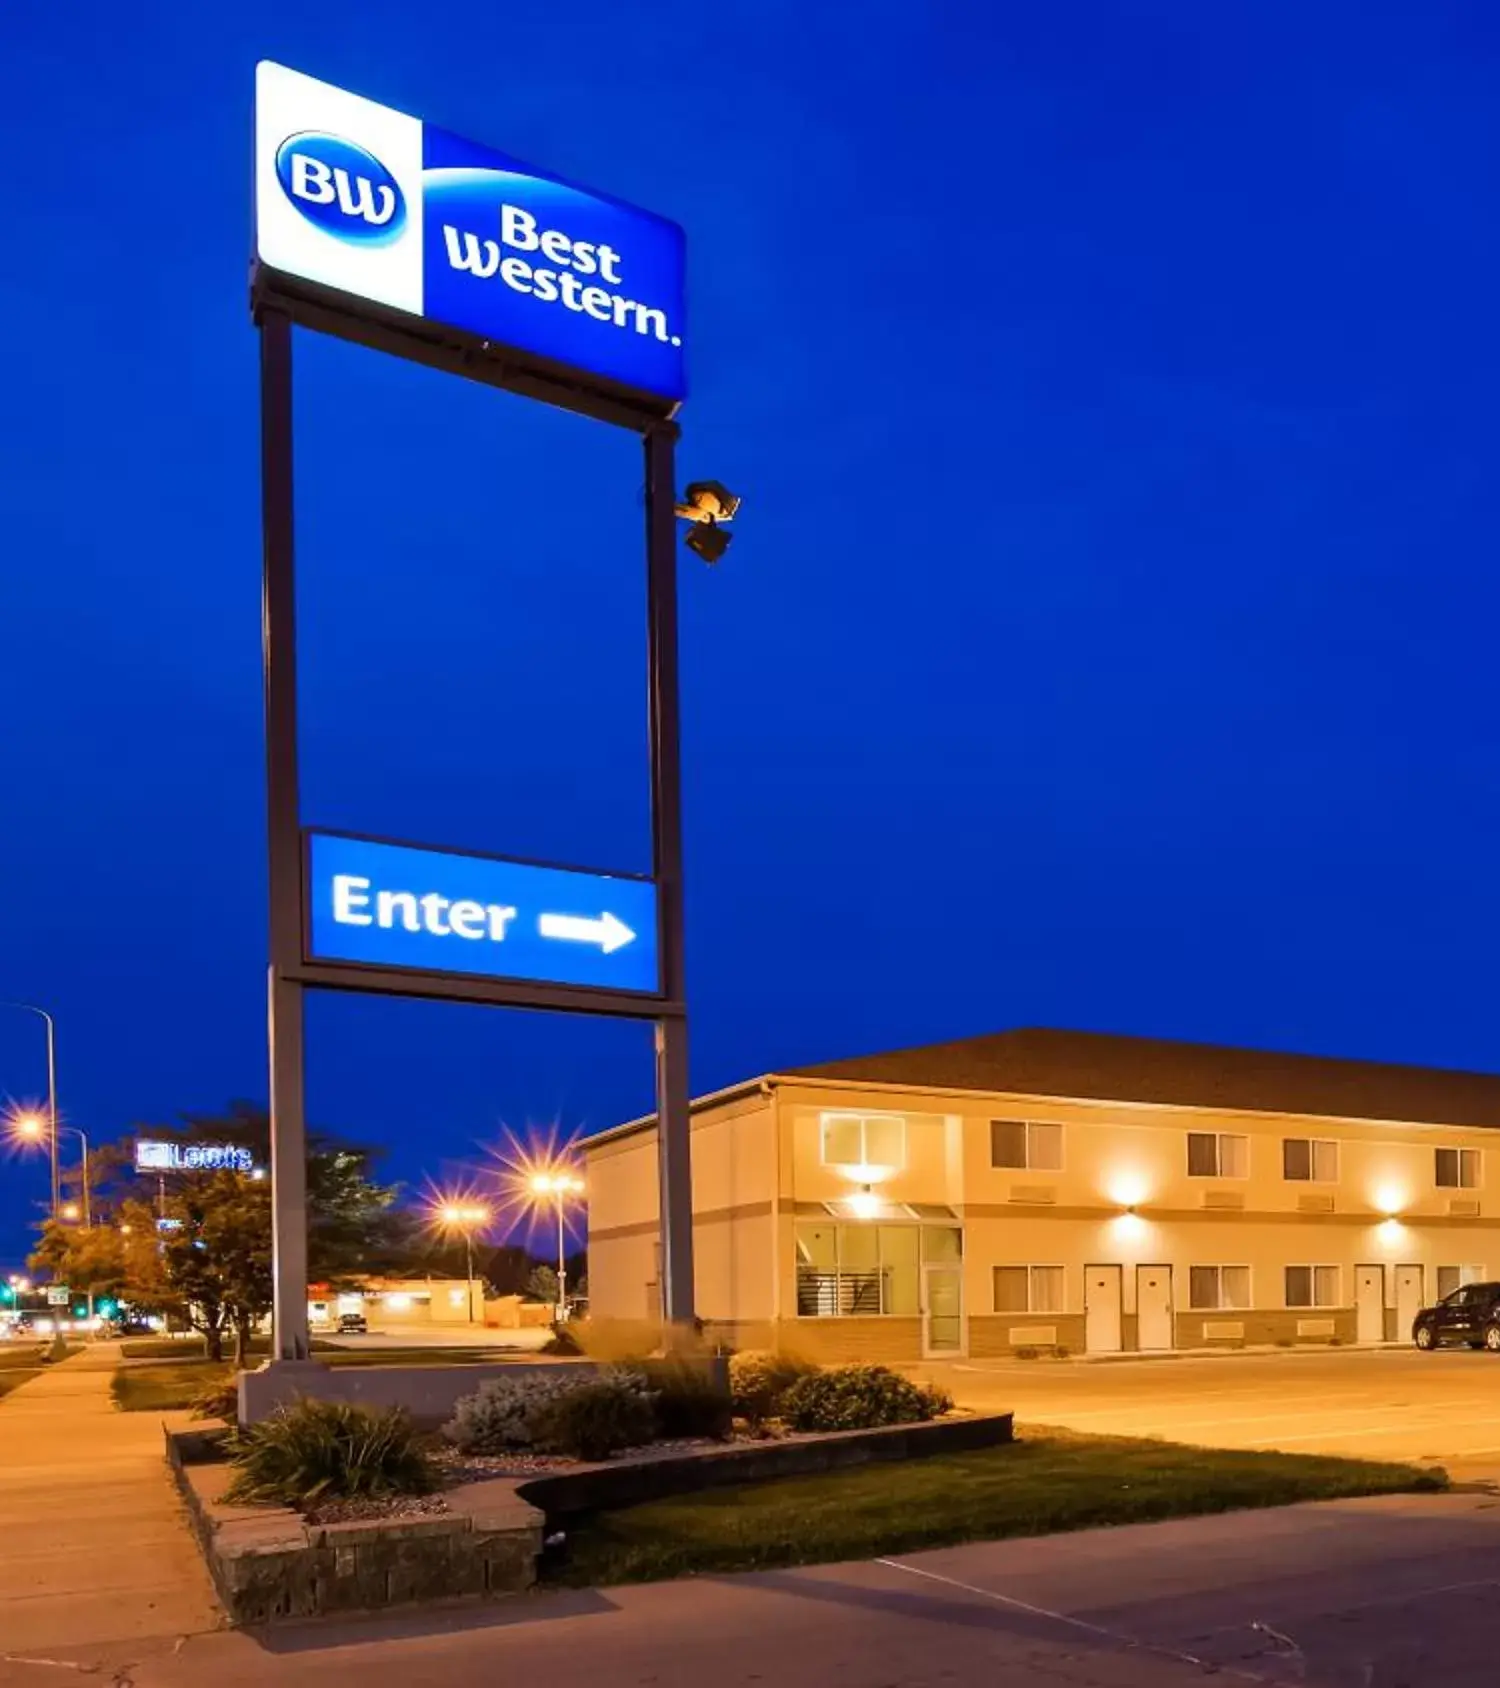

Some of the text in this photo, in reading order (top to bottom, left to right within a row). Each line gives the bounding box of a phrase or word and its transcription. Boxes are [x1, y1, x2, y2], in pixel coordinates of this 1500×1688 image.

[291, 153, 396, 225] BW
[501, 203, 621, 285] Best
[332, 874, 517, 942] Enter
